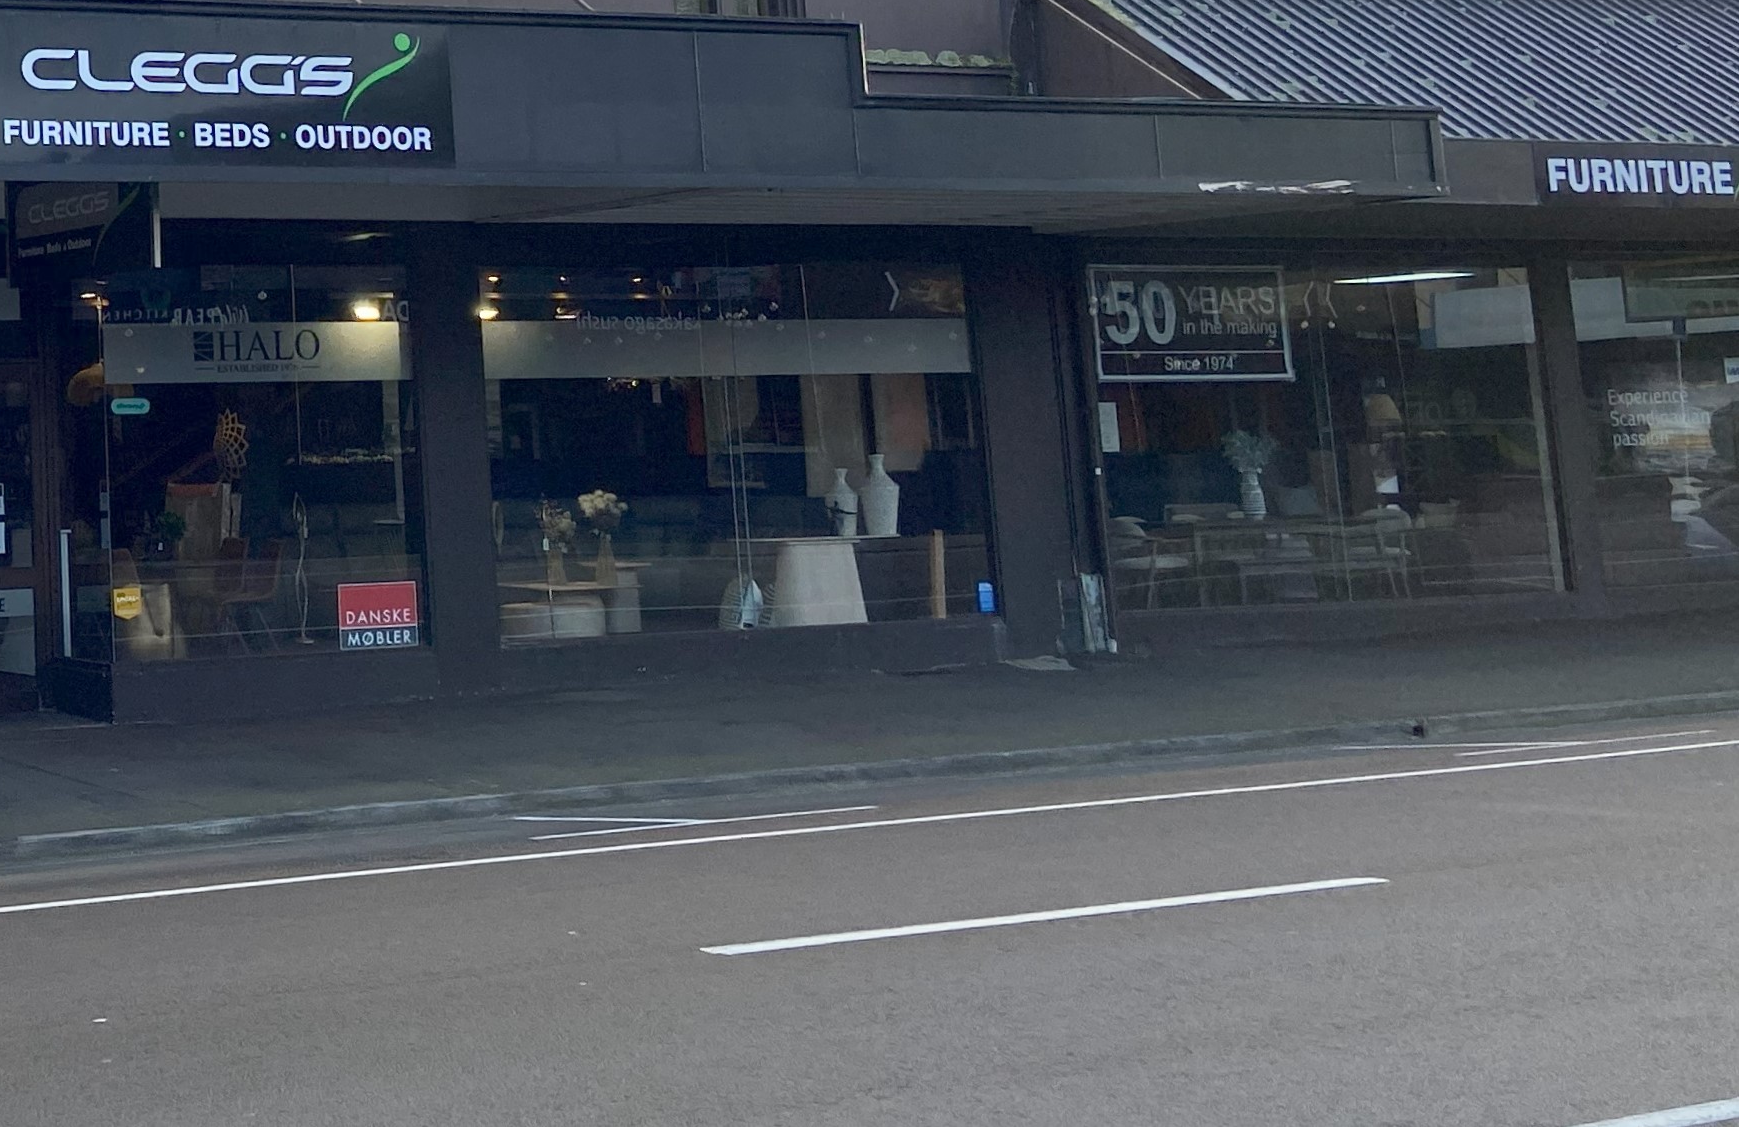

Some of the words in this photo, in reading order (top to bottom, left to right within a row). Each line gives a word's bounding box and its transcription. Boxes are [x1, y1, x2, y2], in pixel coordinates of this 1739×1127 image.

[21, 48, 354, 96] CLEGG'S
[3, 118, 170, 147] FURNITURE
[194, 122, 271, 149] BEDS
[296, 123, 432, 151] OUTDOOR
[1546, 158, 1735, 195] FURNITURE
[1105, 280, 1176, 345] 50
[1178, 285, 1276, 315] YEARS
[1183, 319, 1196, 335] in
[1200, 319, 1223, 335] the
[1227, 319, 1277, 338] making
[216, 329, 321, 361] HALO
[1164, 356, 1200, 371] Since
[1204, 355, 1234, 370] 1974
[1608, 389, 1689, 406] Experience
[1613, 432, 1670, 448] passion
[346, 608, 411, 624] DANSKE
[348, 630, 411, 646] MØBLER
